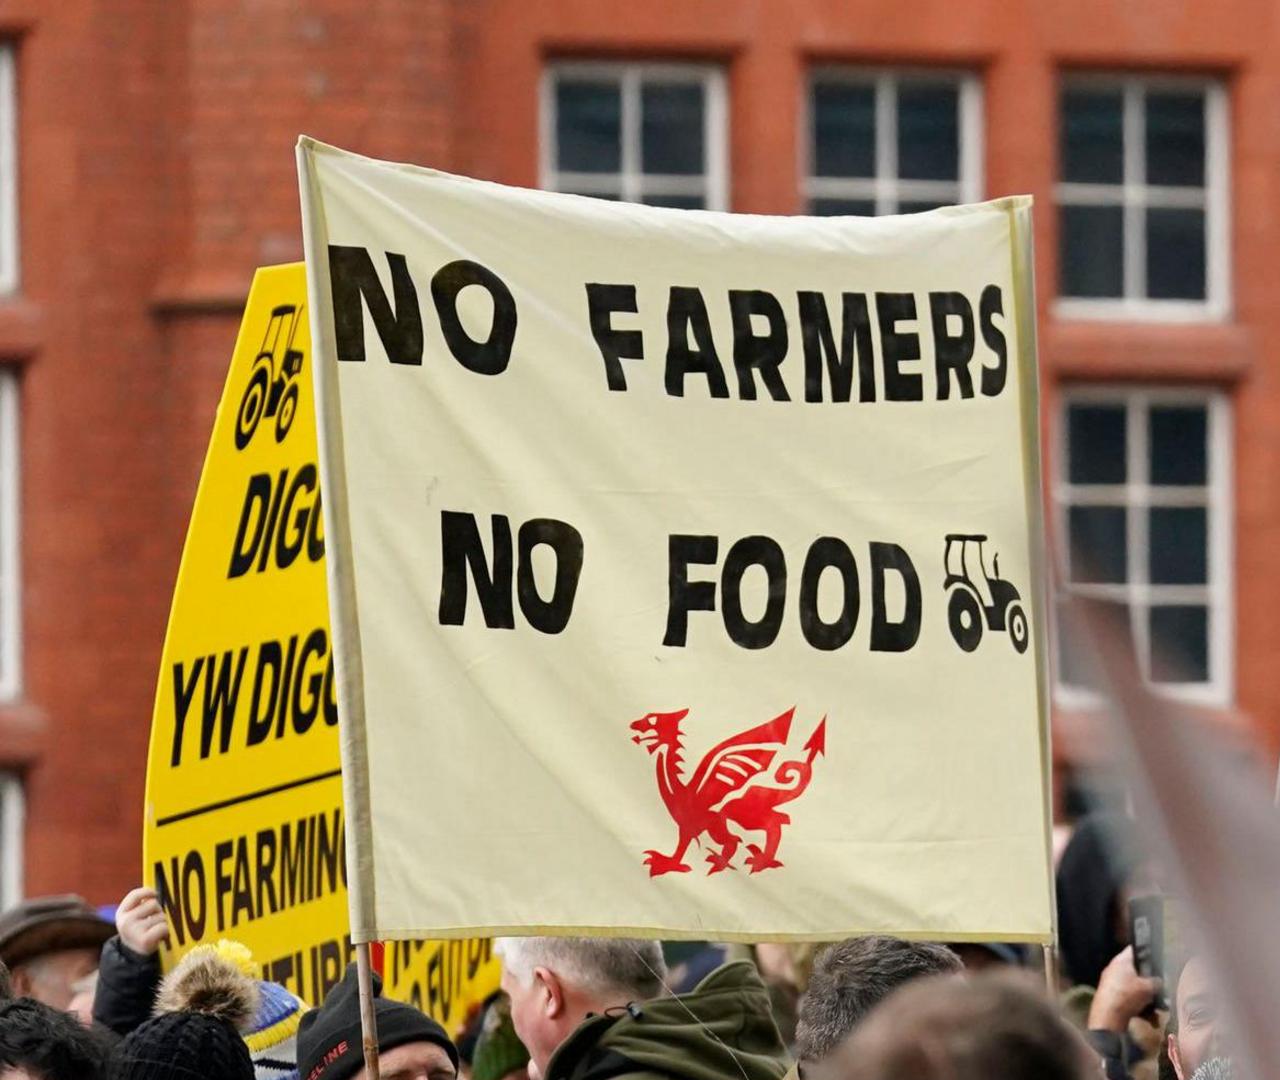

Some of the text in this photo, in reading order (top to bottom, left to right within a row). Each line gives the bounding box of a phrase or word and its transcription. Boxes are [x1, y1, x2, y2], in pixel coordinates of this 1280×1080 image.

[327, 244, 1008, 403] NO FARMERS
[438, 510, 922, 652] NO FOOD
[171, 647, 248, 768] YW
[154, 807, 348, 950] NO FARMIN
